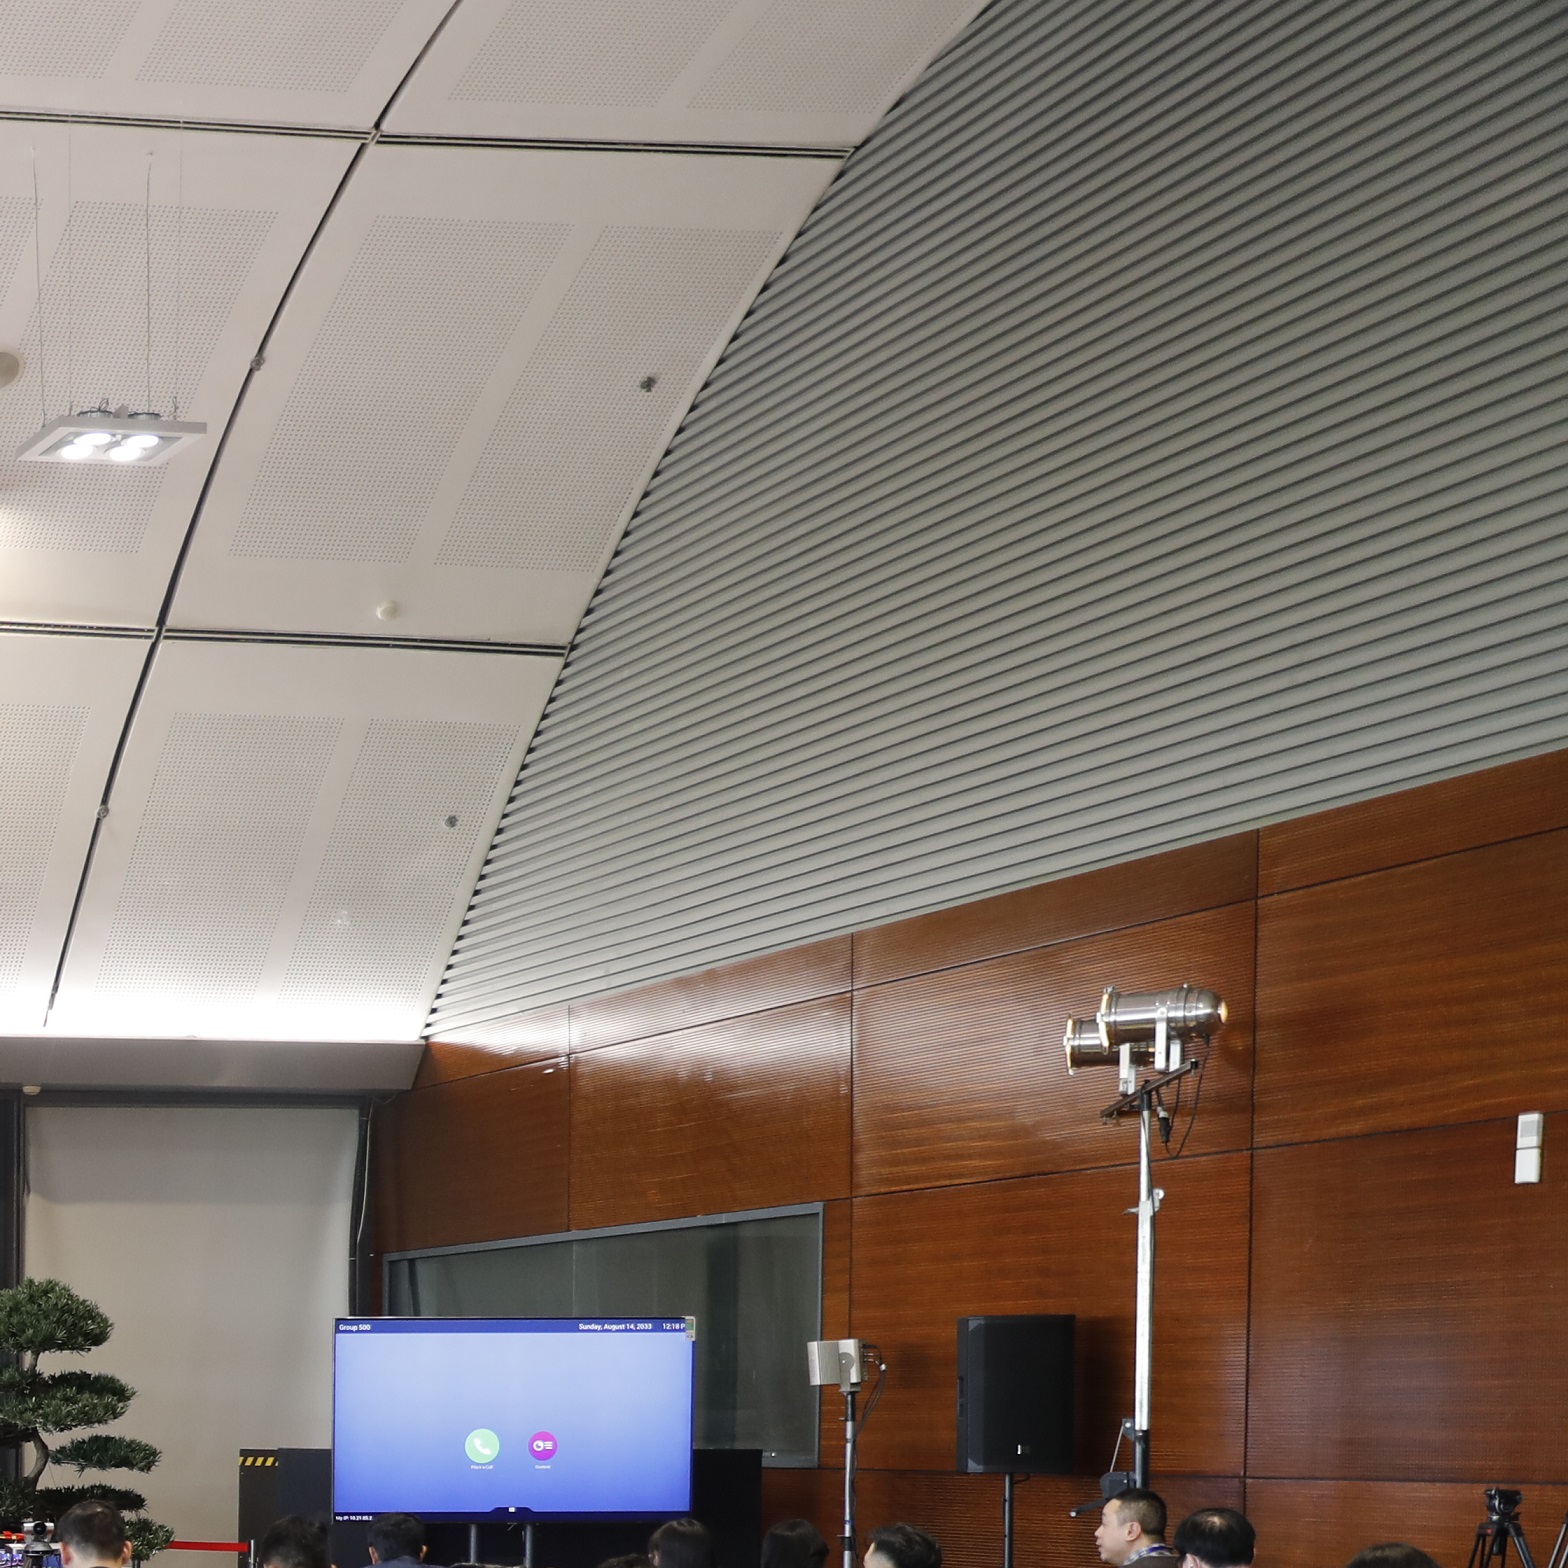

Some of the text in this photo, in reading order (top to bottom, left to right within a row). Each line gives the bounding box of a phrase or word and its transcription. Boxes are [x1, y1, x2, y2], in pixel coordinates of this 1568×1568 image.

[338, 1324, 358, 1332] Group
[578, 1323, 602, 1331] Sunday,
[604, 1323, 625, 1331] August
